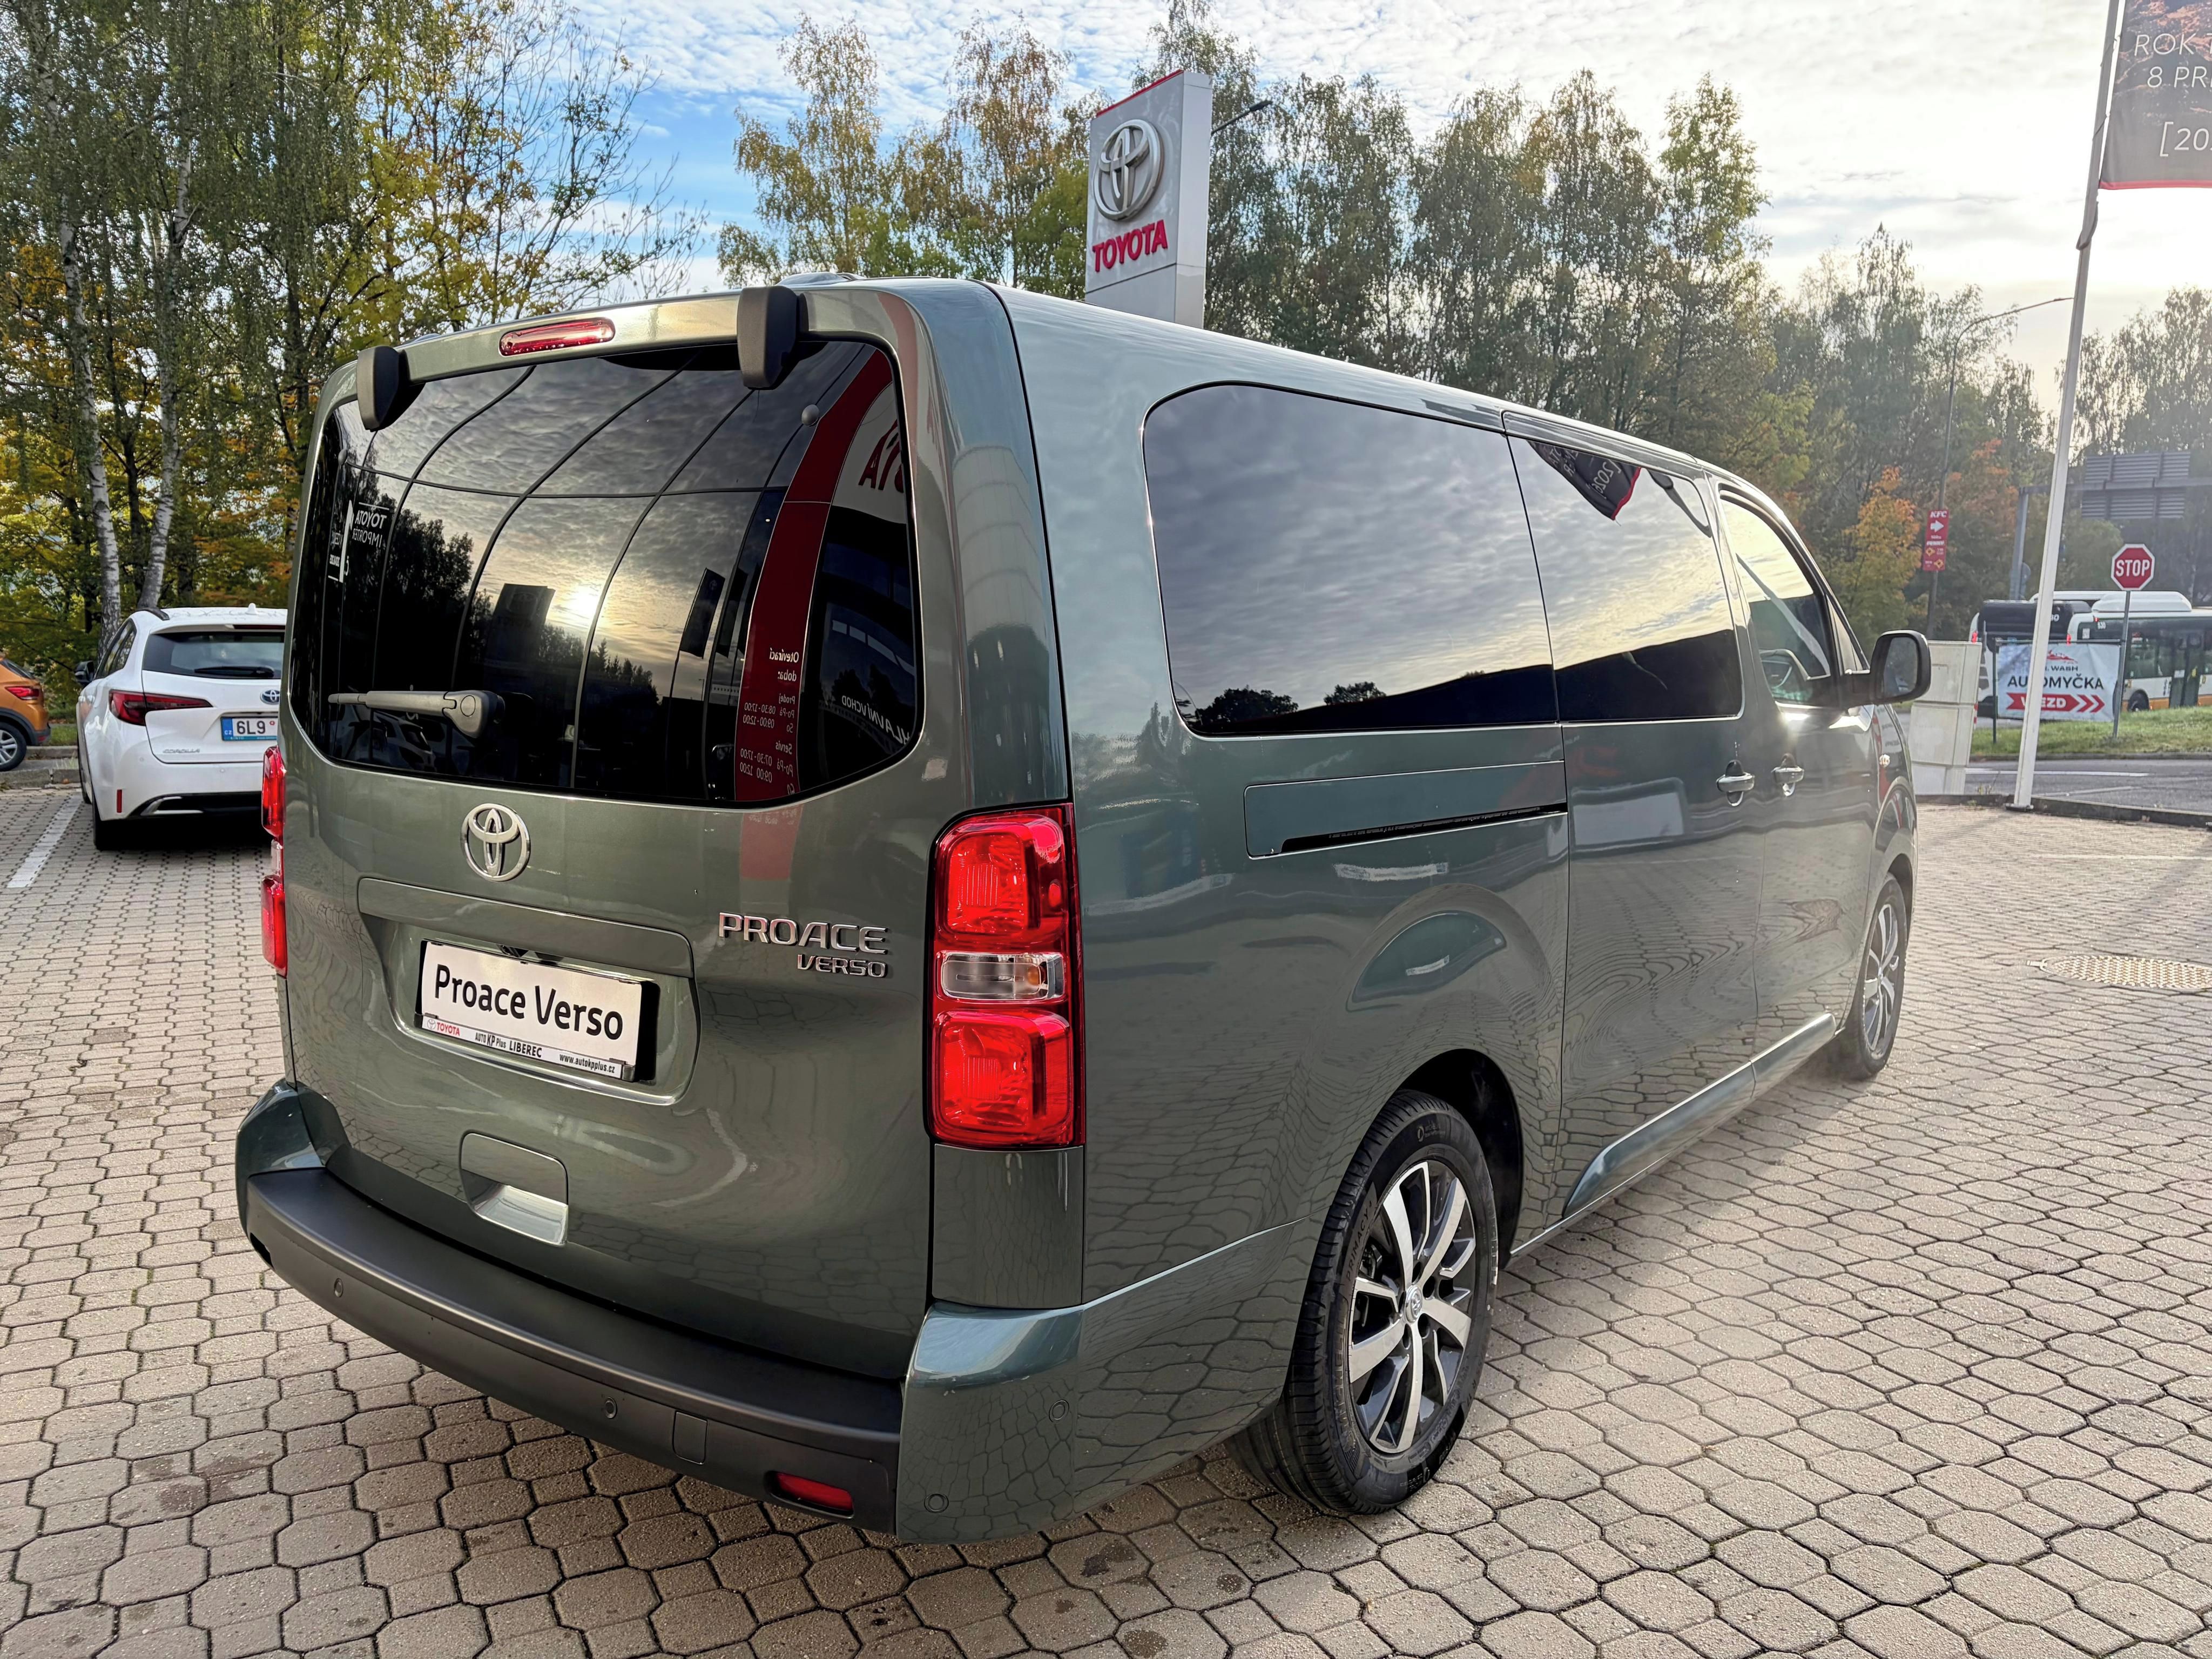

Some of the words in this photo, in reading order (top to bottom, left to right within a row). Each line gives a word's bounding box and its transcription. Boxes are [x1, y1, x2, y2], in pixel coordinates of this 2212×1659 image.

[2134, 33, 2196, 56] ROK
[2147, 66, 2162, 88] 8
[2174, 66, 2212, 87] PR
[2160, 122, 2212, 157] [20
[1092, 219, 1168, 272] TOYOTA
[1930, 510, 1947, 518] KFC
[2115, 558, 2150, 577] STOP
[2007, 673, 2105, 690] AUMYČKA
[237, 720, 266, 735] 6L9
[719, 912, 888, 954] PROACE
[797, 954, 887, 978] VERSO
[434, 963, 526, 1020] Proace
[534, 985, 623, 1040] Verso
[436, 1022, 460, 1037] TOYOTA
[475, 1032, 487, 1043] AUTO
[487, 1034, 496, 1048] KP
[496, 1037, 507, 1049] Plus
[509, 1040, 543, 1058] LIBEREC
[558, 1053, 616, 1074] www.autokpplus.cz
[1346, 1208, 1368, 1282] PRIMACY
